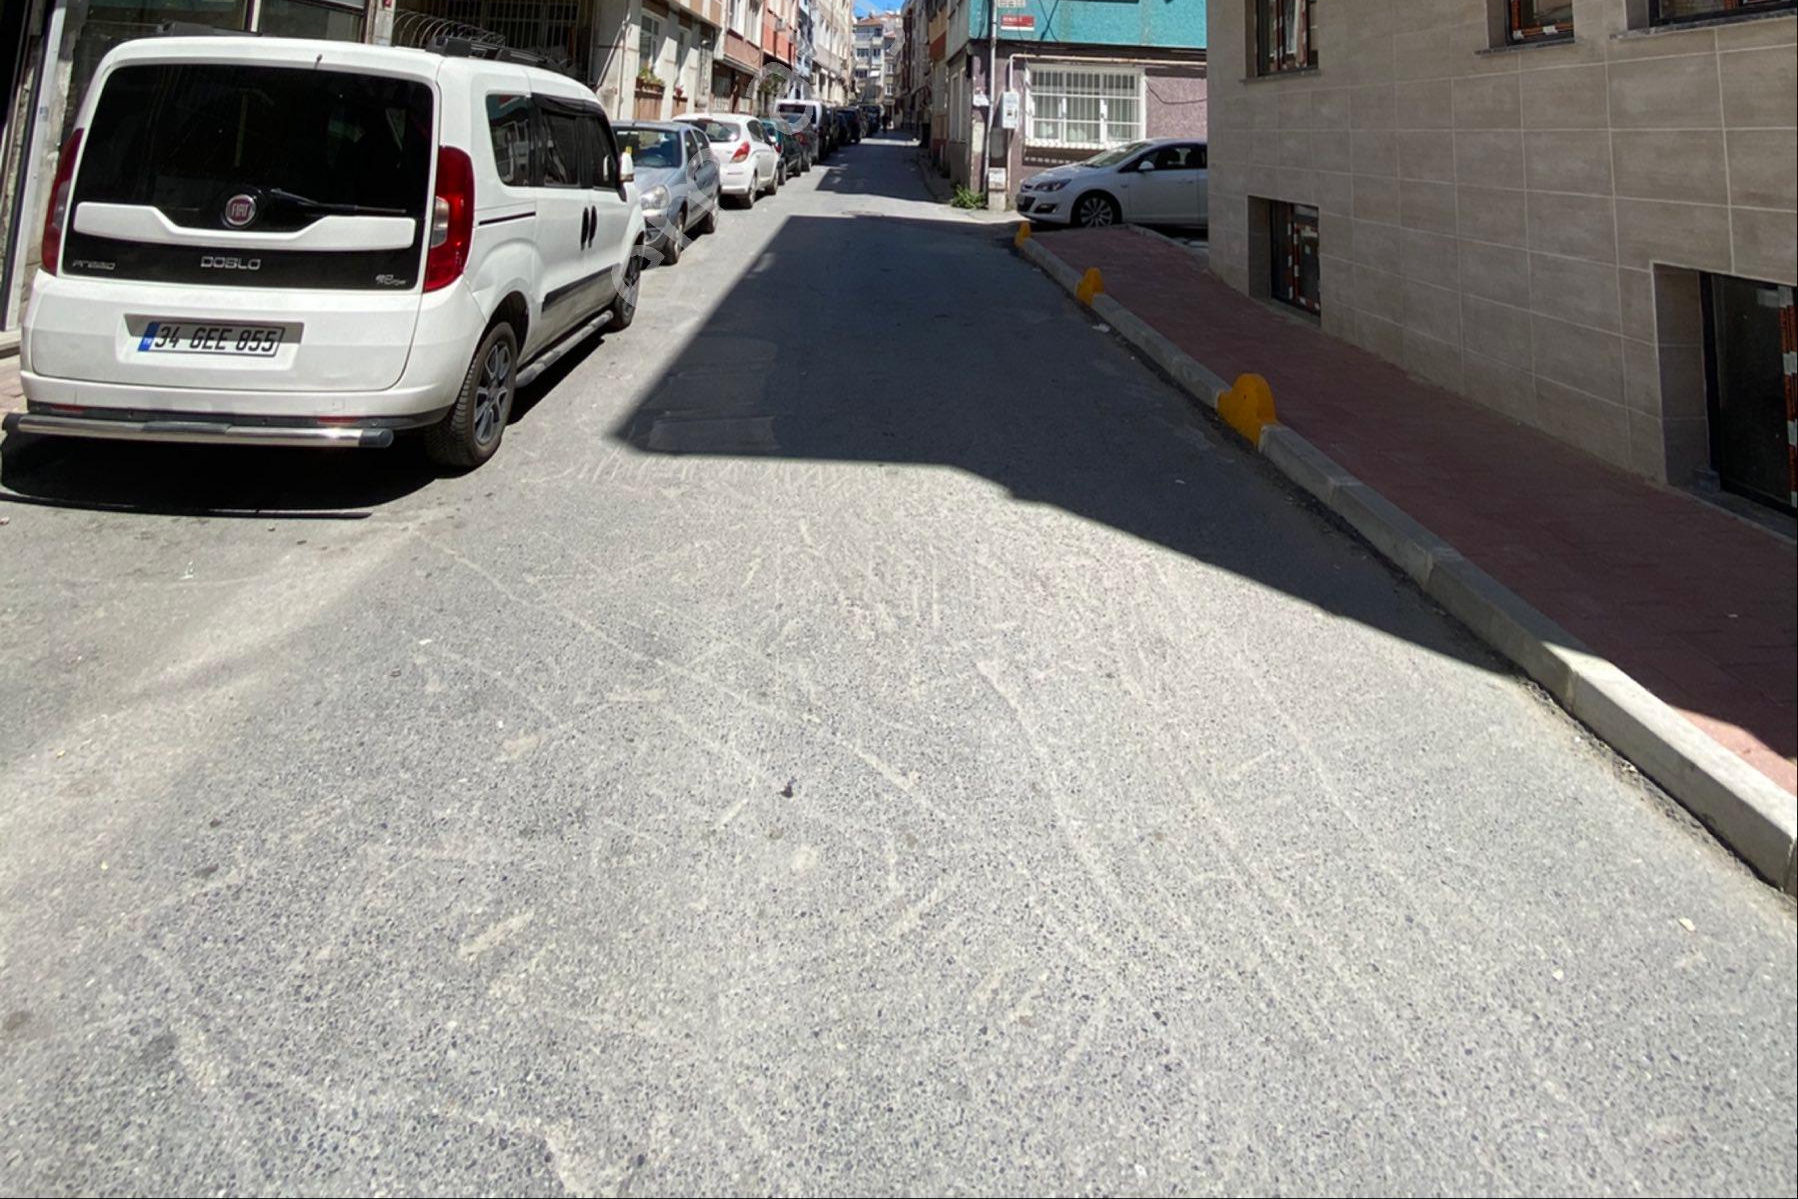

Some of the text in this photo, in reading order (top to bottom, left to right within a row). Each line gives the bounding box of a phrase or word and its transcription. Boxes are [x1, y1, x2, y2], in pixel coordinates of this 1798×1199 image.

[154, 326, 181, 350] 34
[188, 327, 233, 351] GEE
[234, 330, 278, 353] 855
